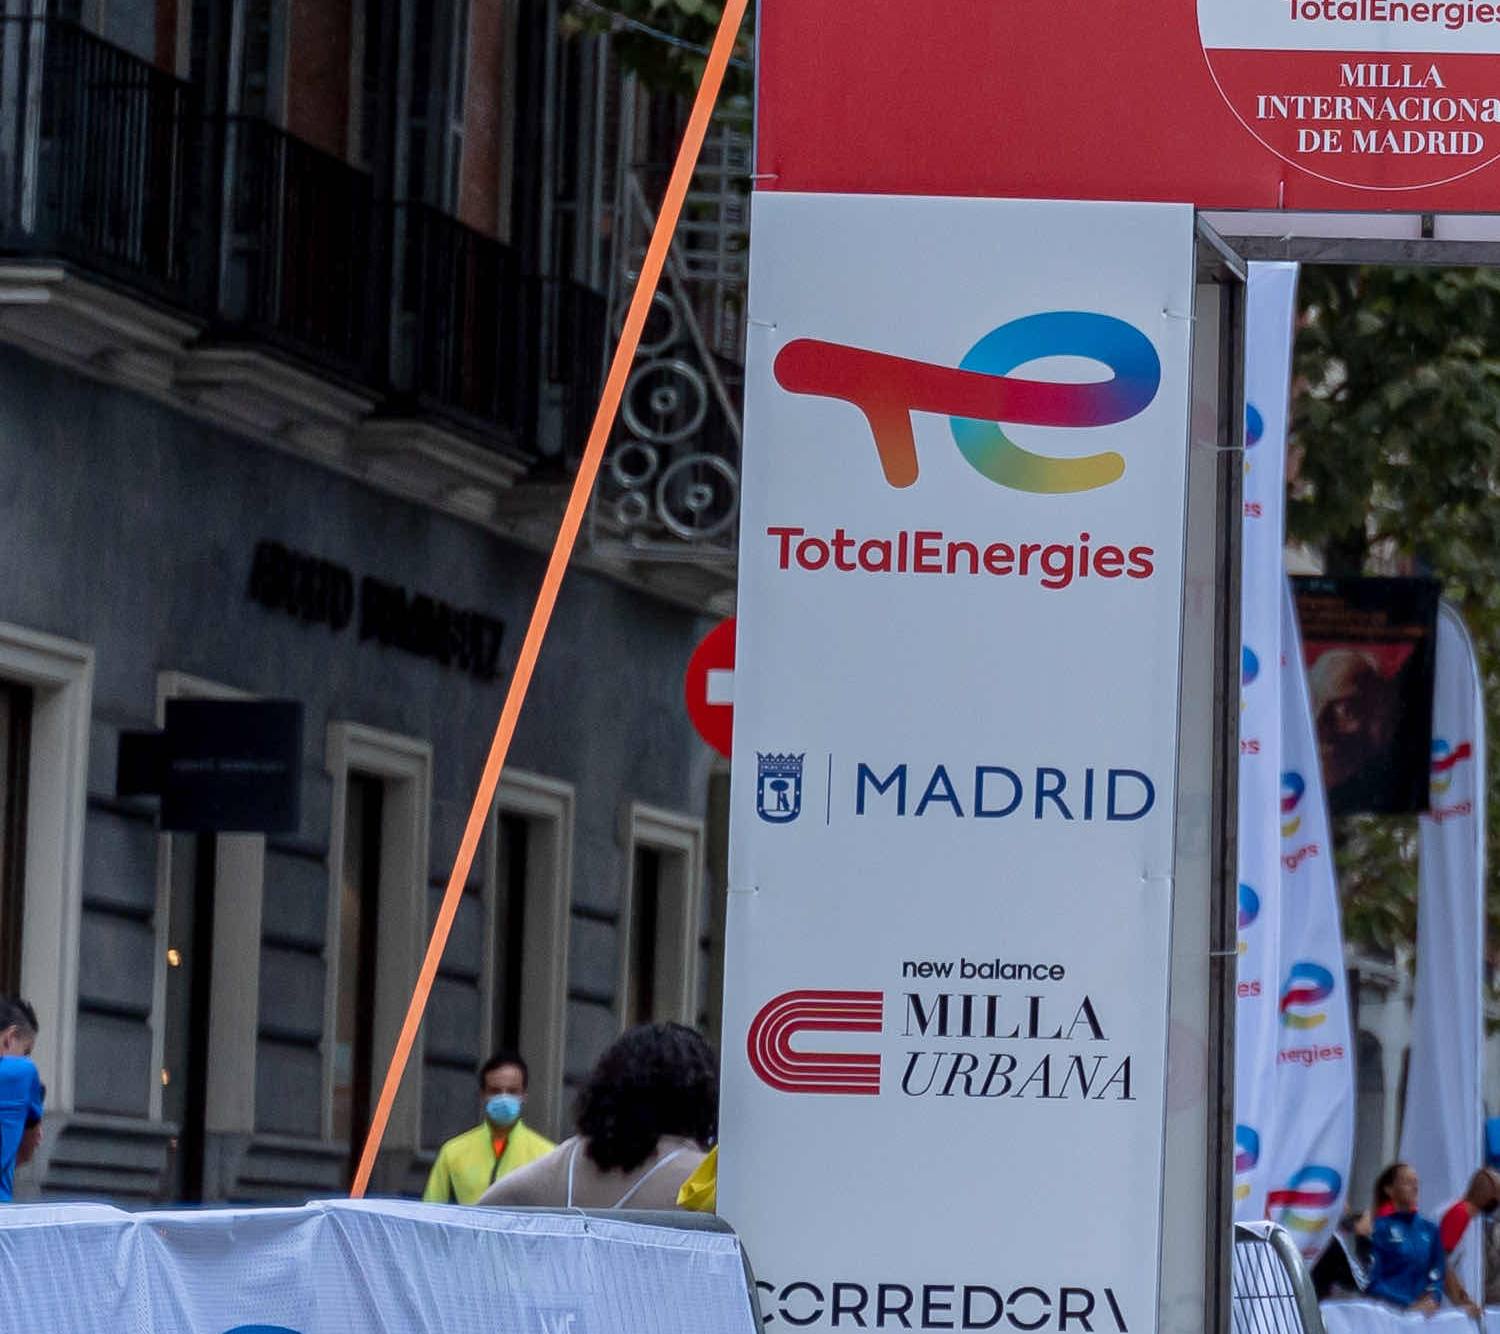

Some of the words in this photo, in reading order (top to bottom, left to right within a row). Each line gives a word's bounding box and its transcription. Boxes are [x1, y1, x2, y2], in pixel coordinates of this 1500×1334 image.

[1339, 63, 1446, 89] MILLA
[1297, 129, 1343, 154] DE
[1351, 129, 1485, 158] MADRID
[766, 526, 1154, 590] TotalEnergies
[855, 762, 1156, 822] MADRID
[902, 961, 955, 979] new
[959, 957, 1066, 982] balance
[901, 992, 1110, 1041] MILLA
[901, 1051, 1137, 1101] URBANA
